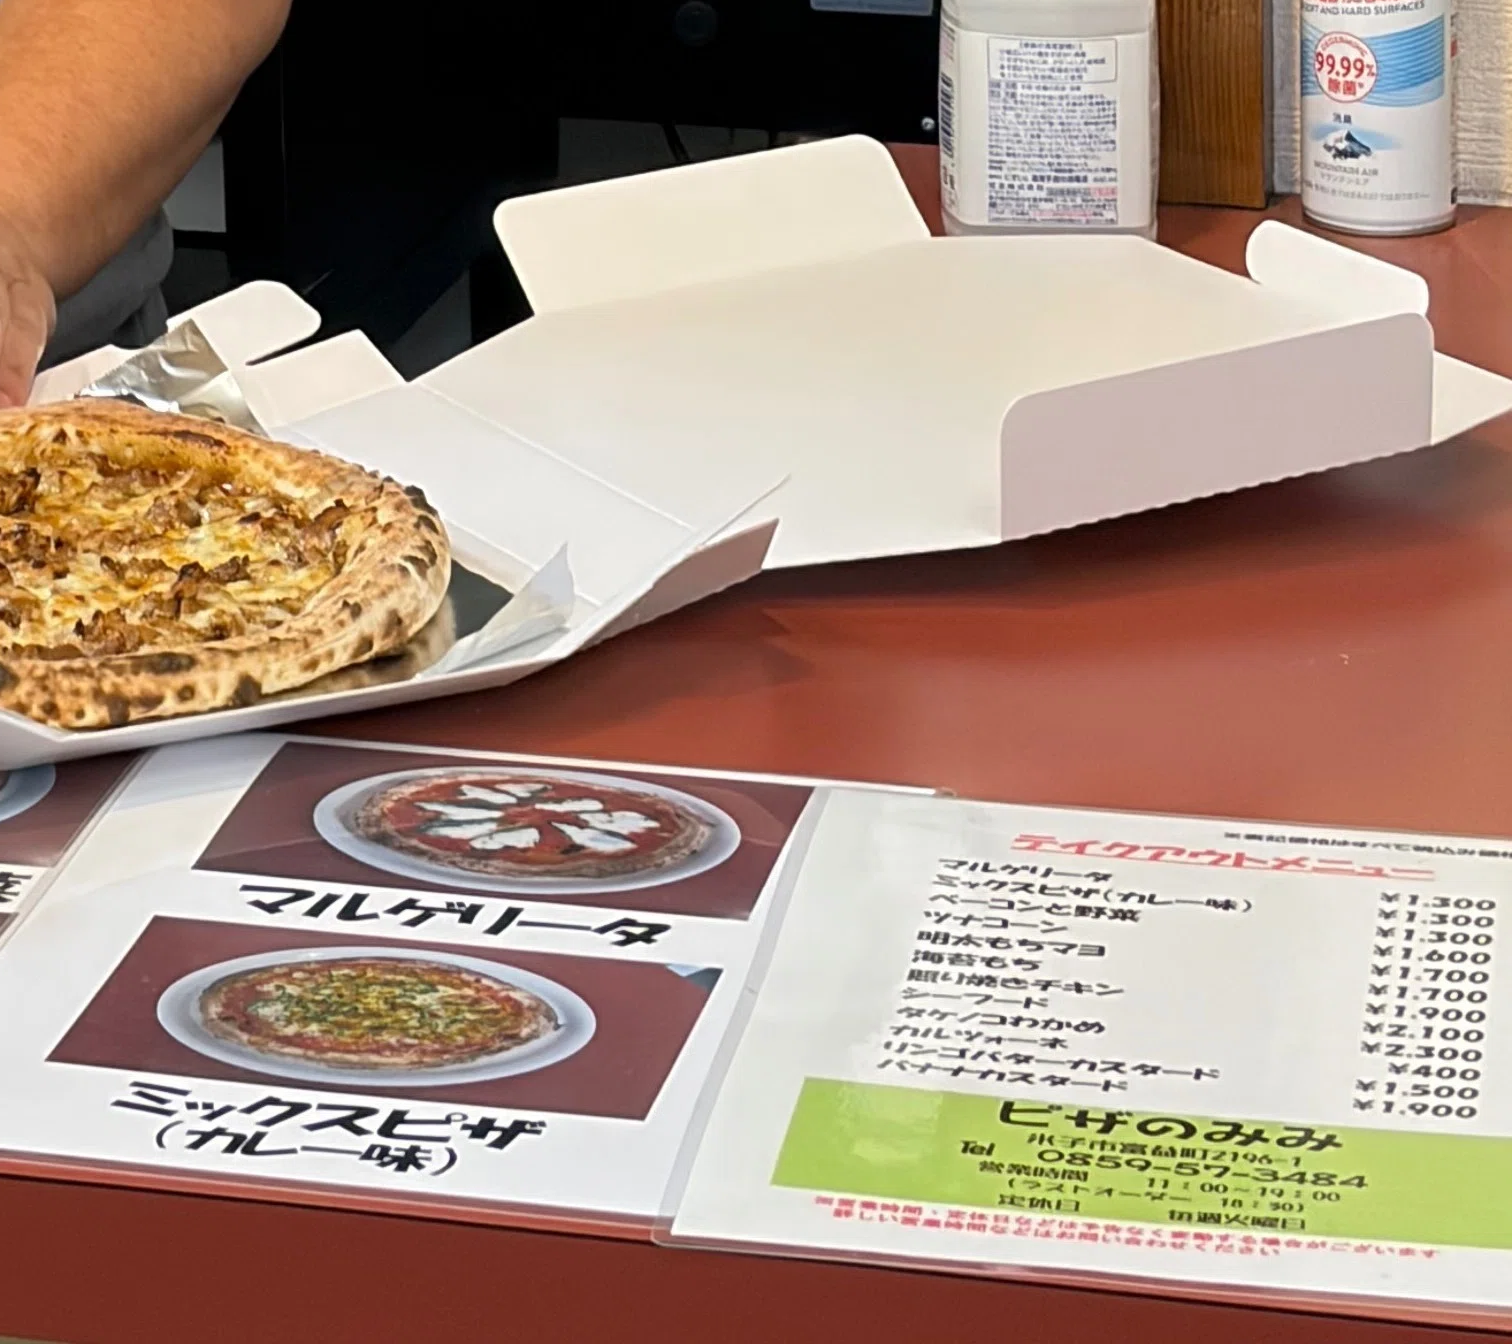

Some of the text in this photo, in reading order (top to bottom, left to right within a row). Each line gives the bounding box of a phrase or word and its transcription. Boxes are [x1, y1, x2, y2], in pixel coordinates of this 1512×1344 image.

[1320, 7, 1339, 16] AND
[1341, 7, 1371, 16] HARD
[1373, 0, 1425, 16] SURFACES
[1315, 51, 1376, 79] 99.99%
[937, 858, 1113, 882] マルゲリータ
[1012, 833, 1436, 879] テイクアウトメニュー
[238, 884, 673, 948] マルゲリータ
[923, 910, 1068, 934] ツナコーン
[928, 893, 1141, 923] ベーコンと野菜
[916, 929, 1107, 957] 明太もちマヨ
[911, 949, 1043, 972] 海苔もち
[906, 968, 1125, 996] 照り焼きチキン
[900, 986, 1049, 1009] シーフード
[896, 1005, 1106, 1034] タケノコわかめ
[889, 1023, 1068, 1049] カルツォーネ
[110, 1080, 548, 1151] ミックスピザ
[959, 1139, 1370, 1190] Tel 0859-57-3484
[978, 1159, 1090, 1182] 営業時間
[997, 1192, 1307, 1231] 定休日 毎週火曜日
